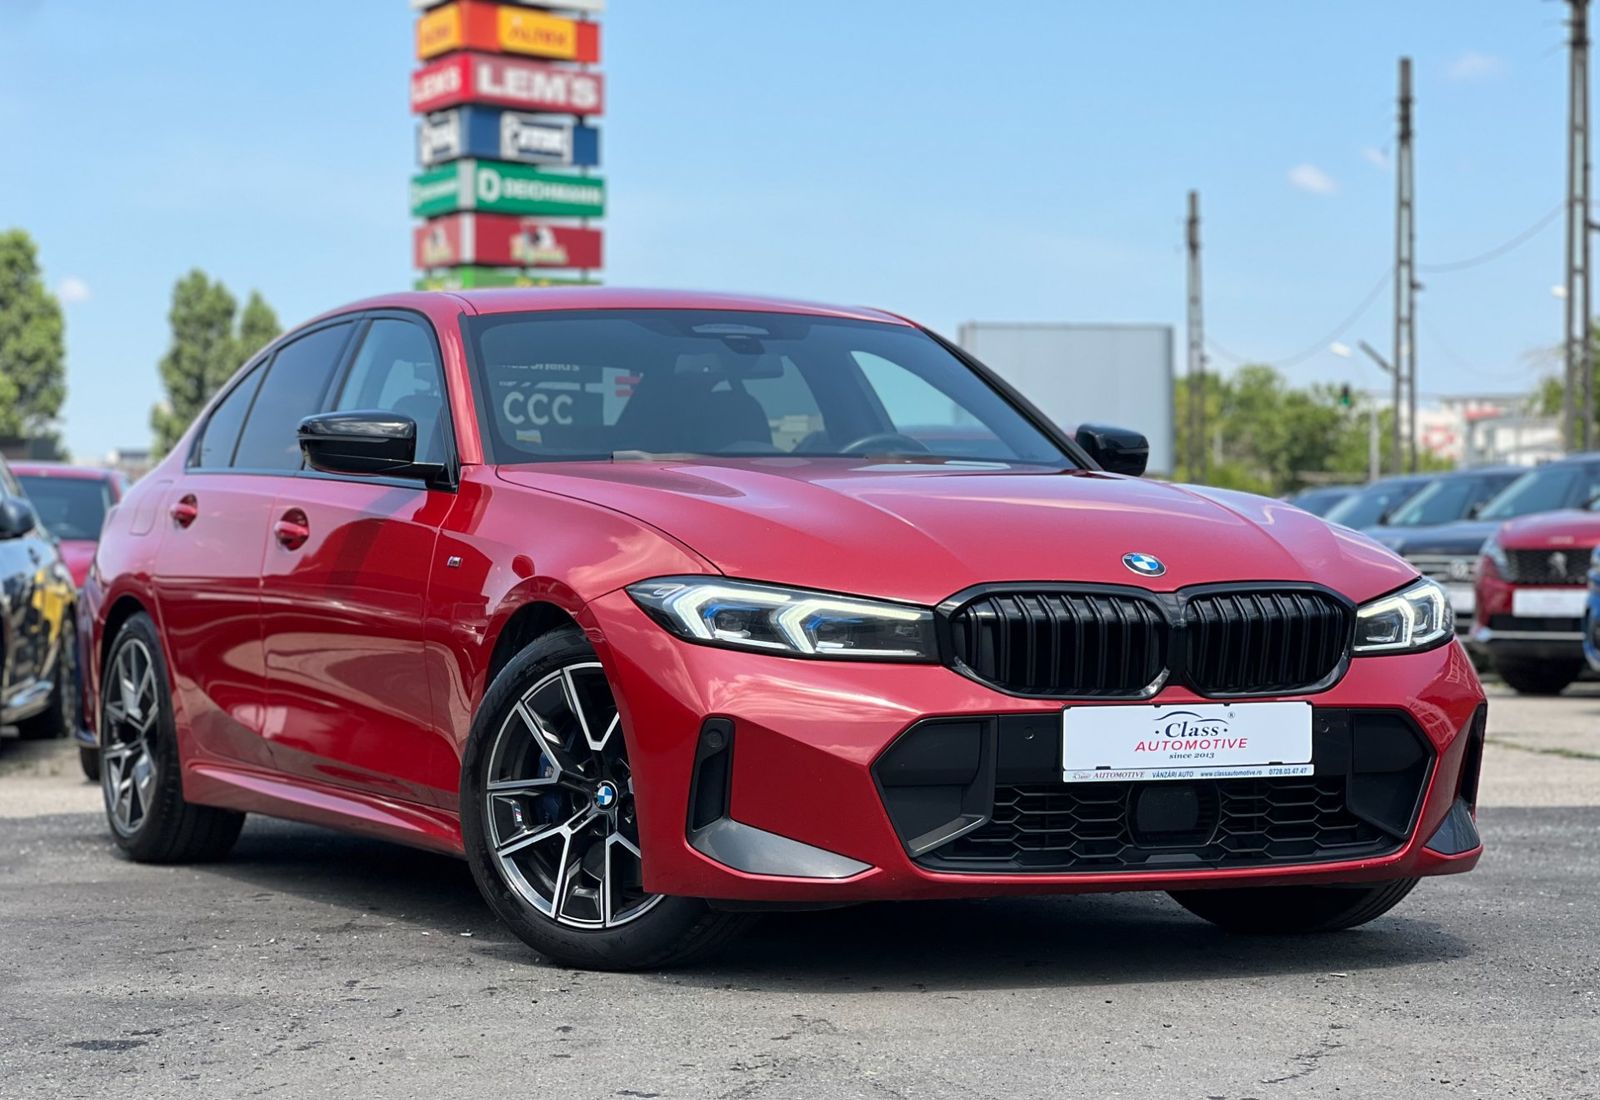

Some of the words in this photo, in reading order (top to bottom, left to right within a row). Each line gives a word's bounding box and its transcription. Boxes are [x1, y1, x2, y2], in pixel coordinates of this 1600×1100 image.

[503, 391, 573, 425] CCC
[1165, 720, 1220, 738] Class
[1134, 738, 1248, 752] AUTOMOTIVE
[1169, 752, 1192, 760] since
[1193, 751, 1215, 759] 2013
[1093, 771, 1146, 779] AUTOMOTIVE
[1178, 770, 1194, 778] AUTO
